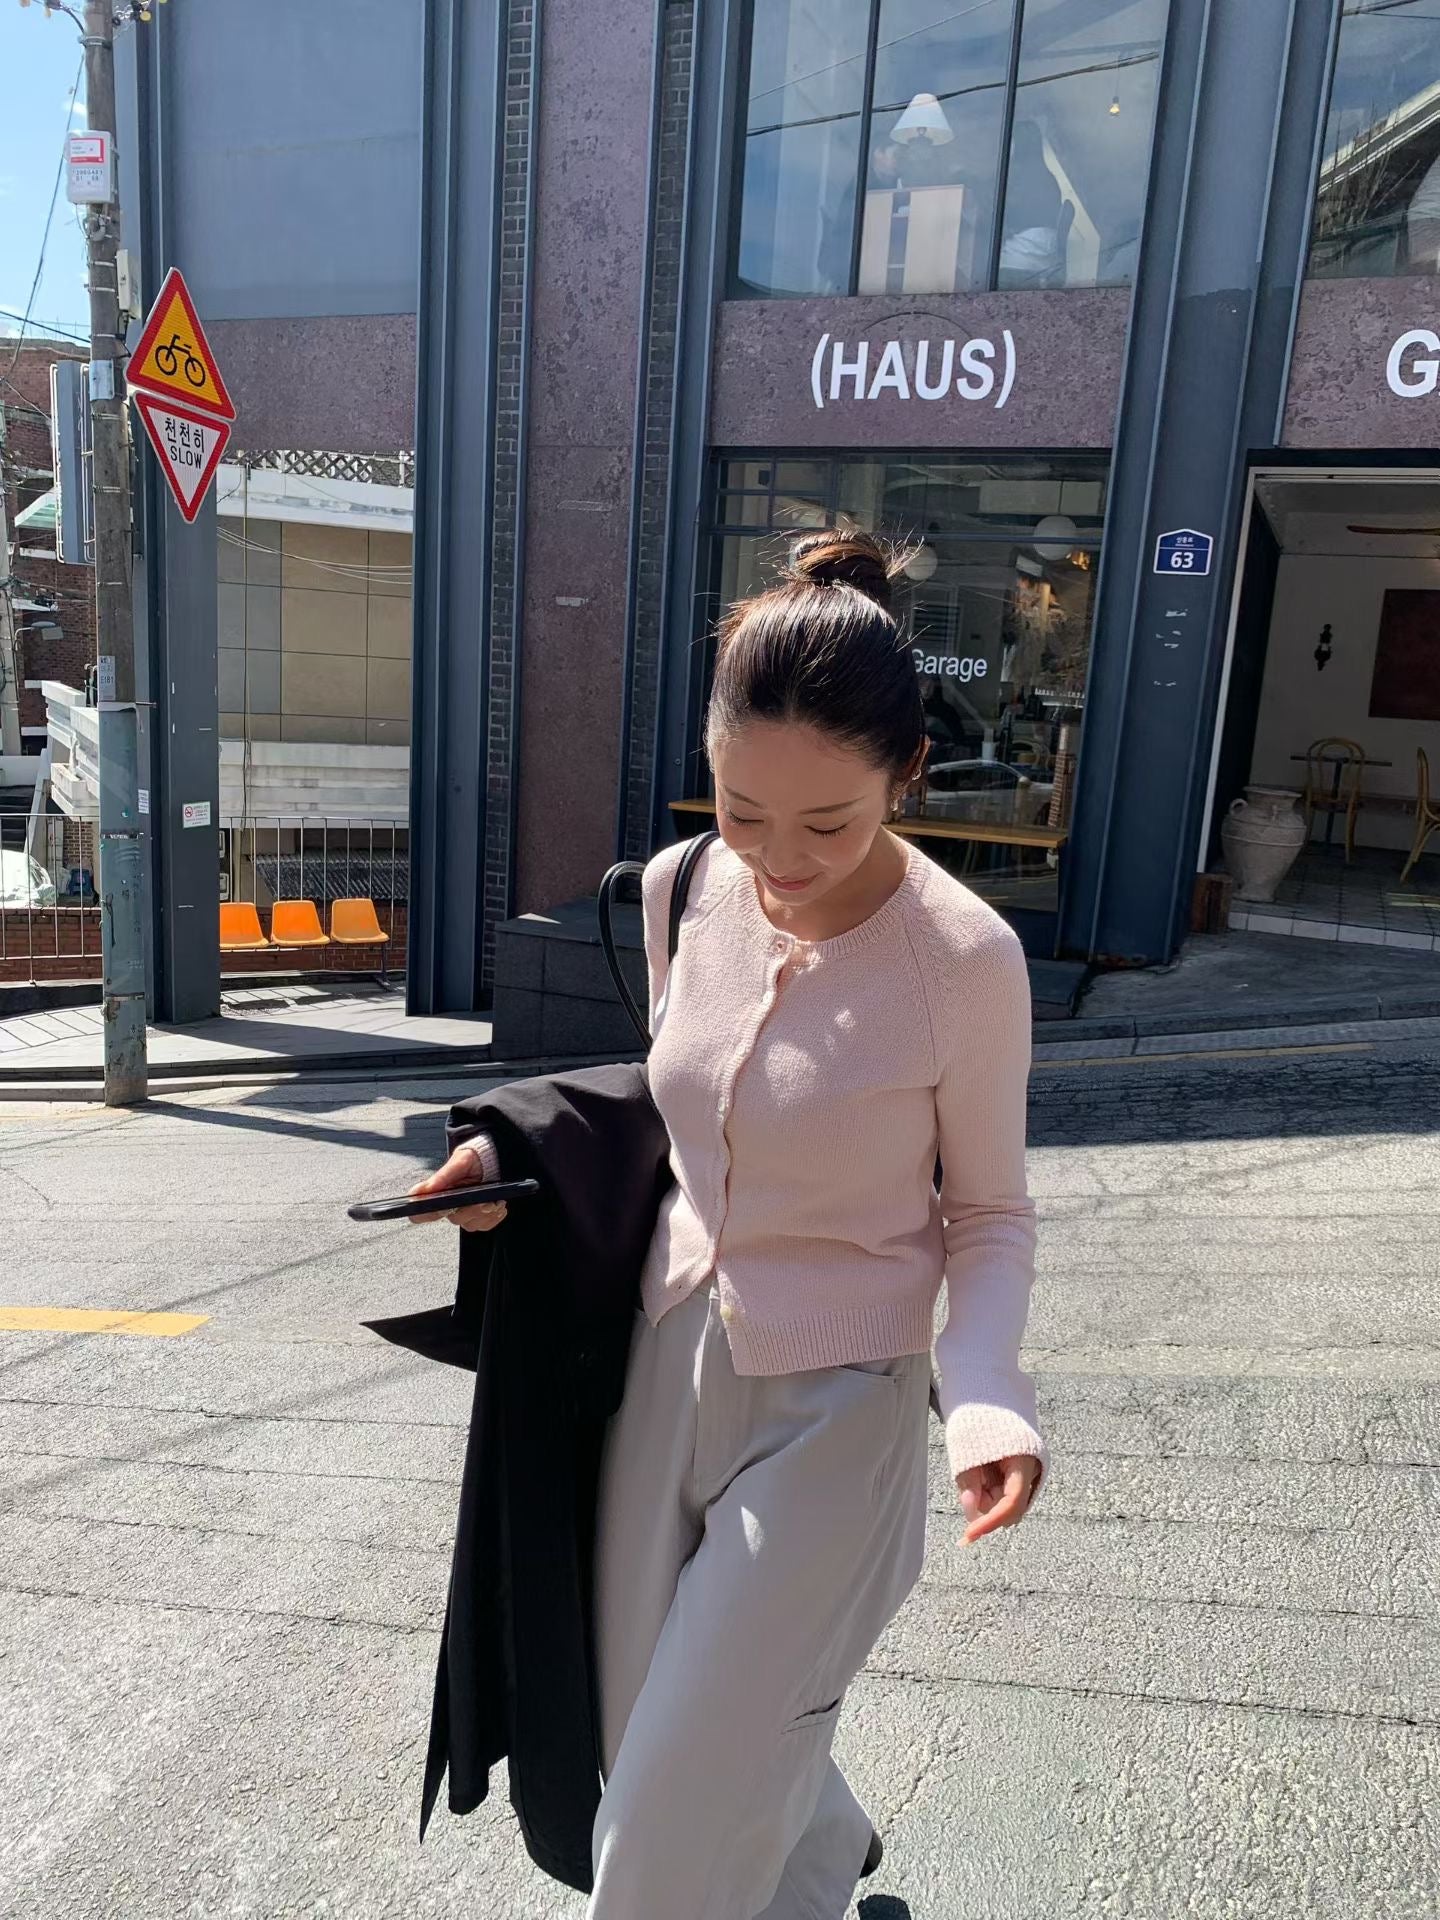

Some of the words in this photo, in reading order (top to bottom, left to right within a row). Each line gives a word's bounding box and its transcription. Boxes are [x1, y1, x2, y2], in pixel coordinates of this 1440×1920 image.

[811, 330, 1016, 408] (HAUS)
[165, 417, 204, 453] 천천히
[170, 445, 202, 469] SLOW
[1170, 551, 1194, 569] 63
[911, 648, 988, 683] Garage
